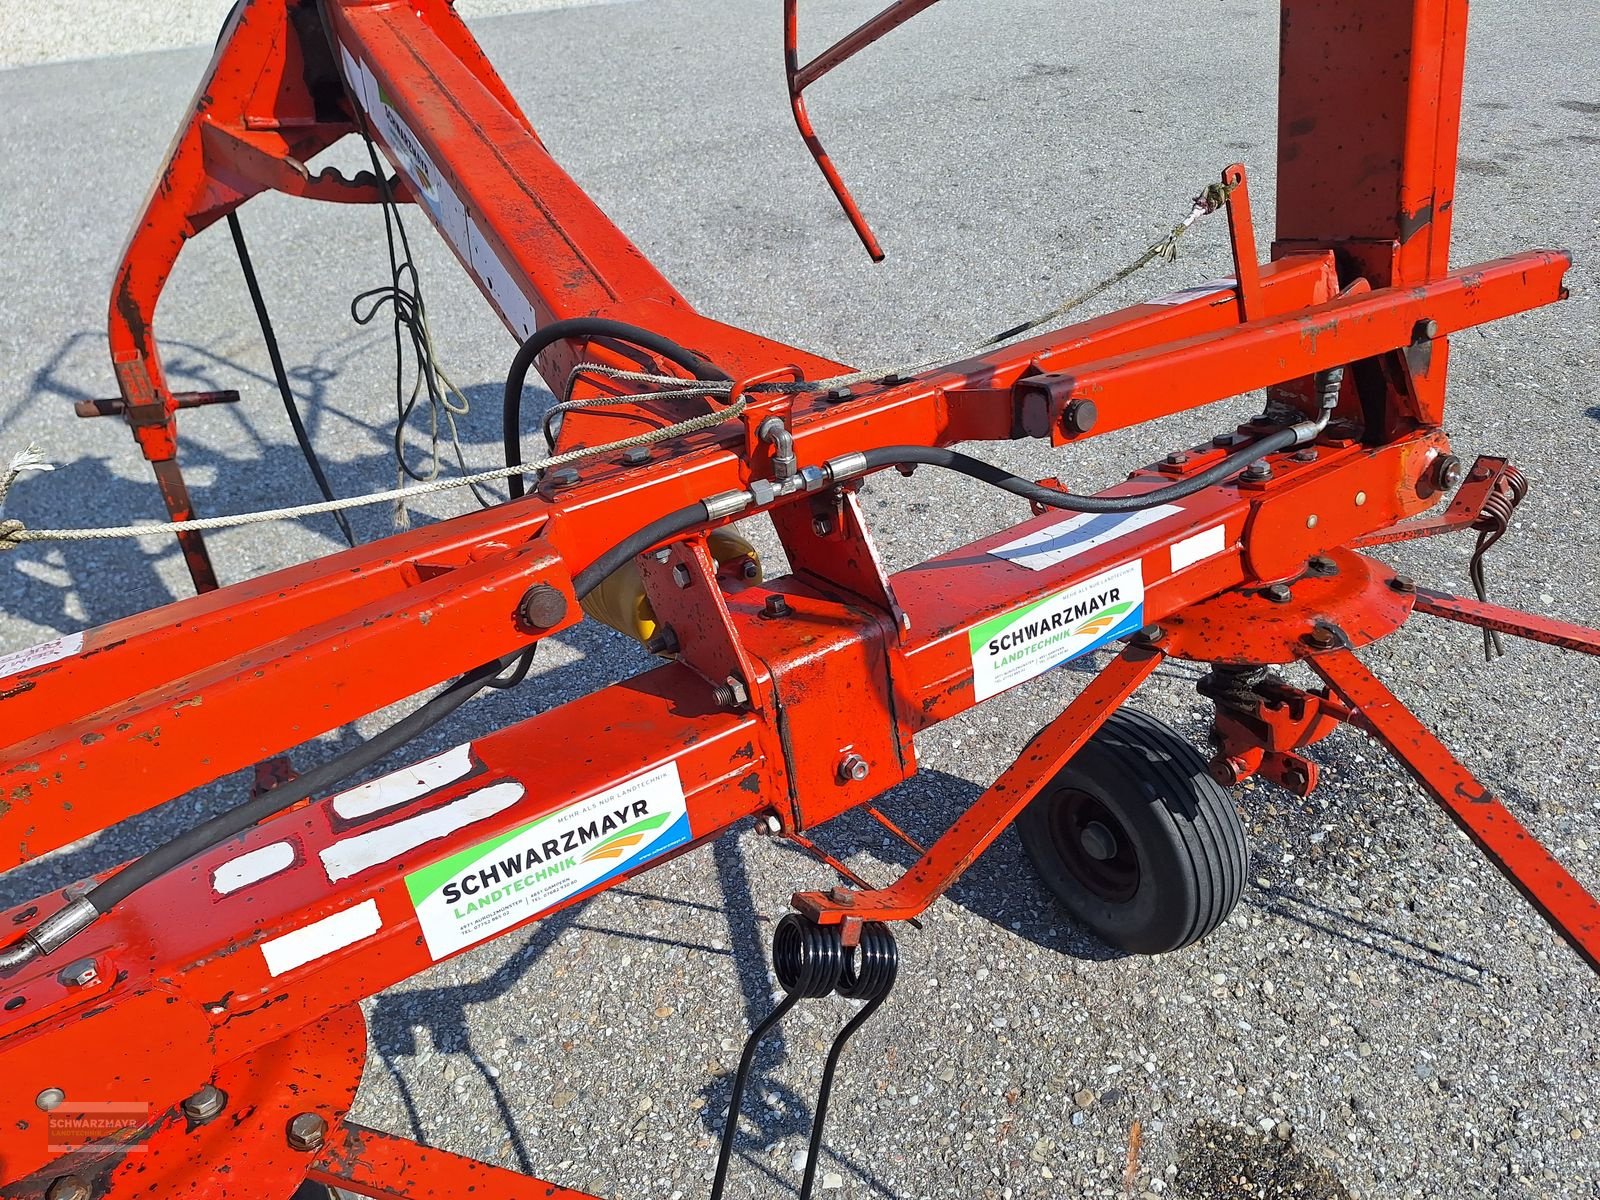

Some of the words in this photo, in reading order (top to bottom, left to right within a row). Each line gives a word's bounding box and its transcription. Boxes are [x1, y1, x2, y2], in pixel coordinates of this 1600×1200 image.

[989, 588, 1121, 655] SCHWARZMAYR
[994, 629, 1071, 670] LANDTECHNIK
[557, 810, 579, 823] MEHR
[582, 803, 597, 813] ALS
[599, 795, 615, 806] NUR
[617, 773, 668, 798] LANDTECHNIK
[443, 800, 649, 904] SCHWARZMAYR
[454, 856, 577, 919] LANDTECHNIK
